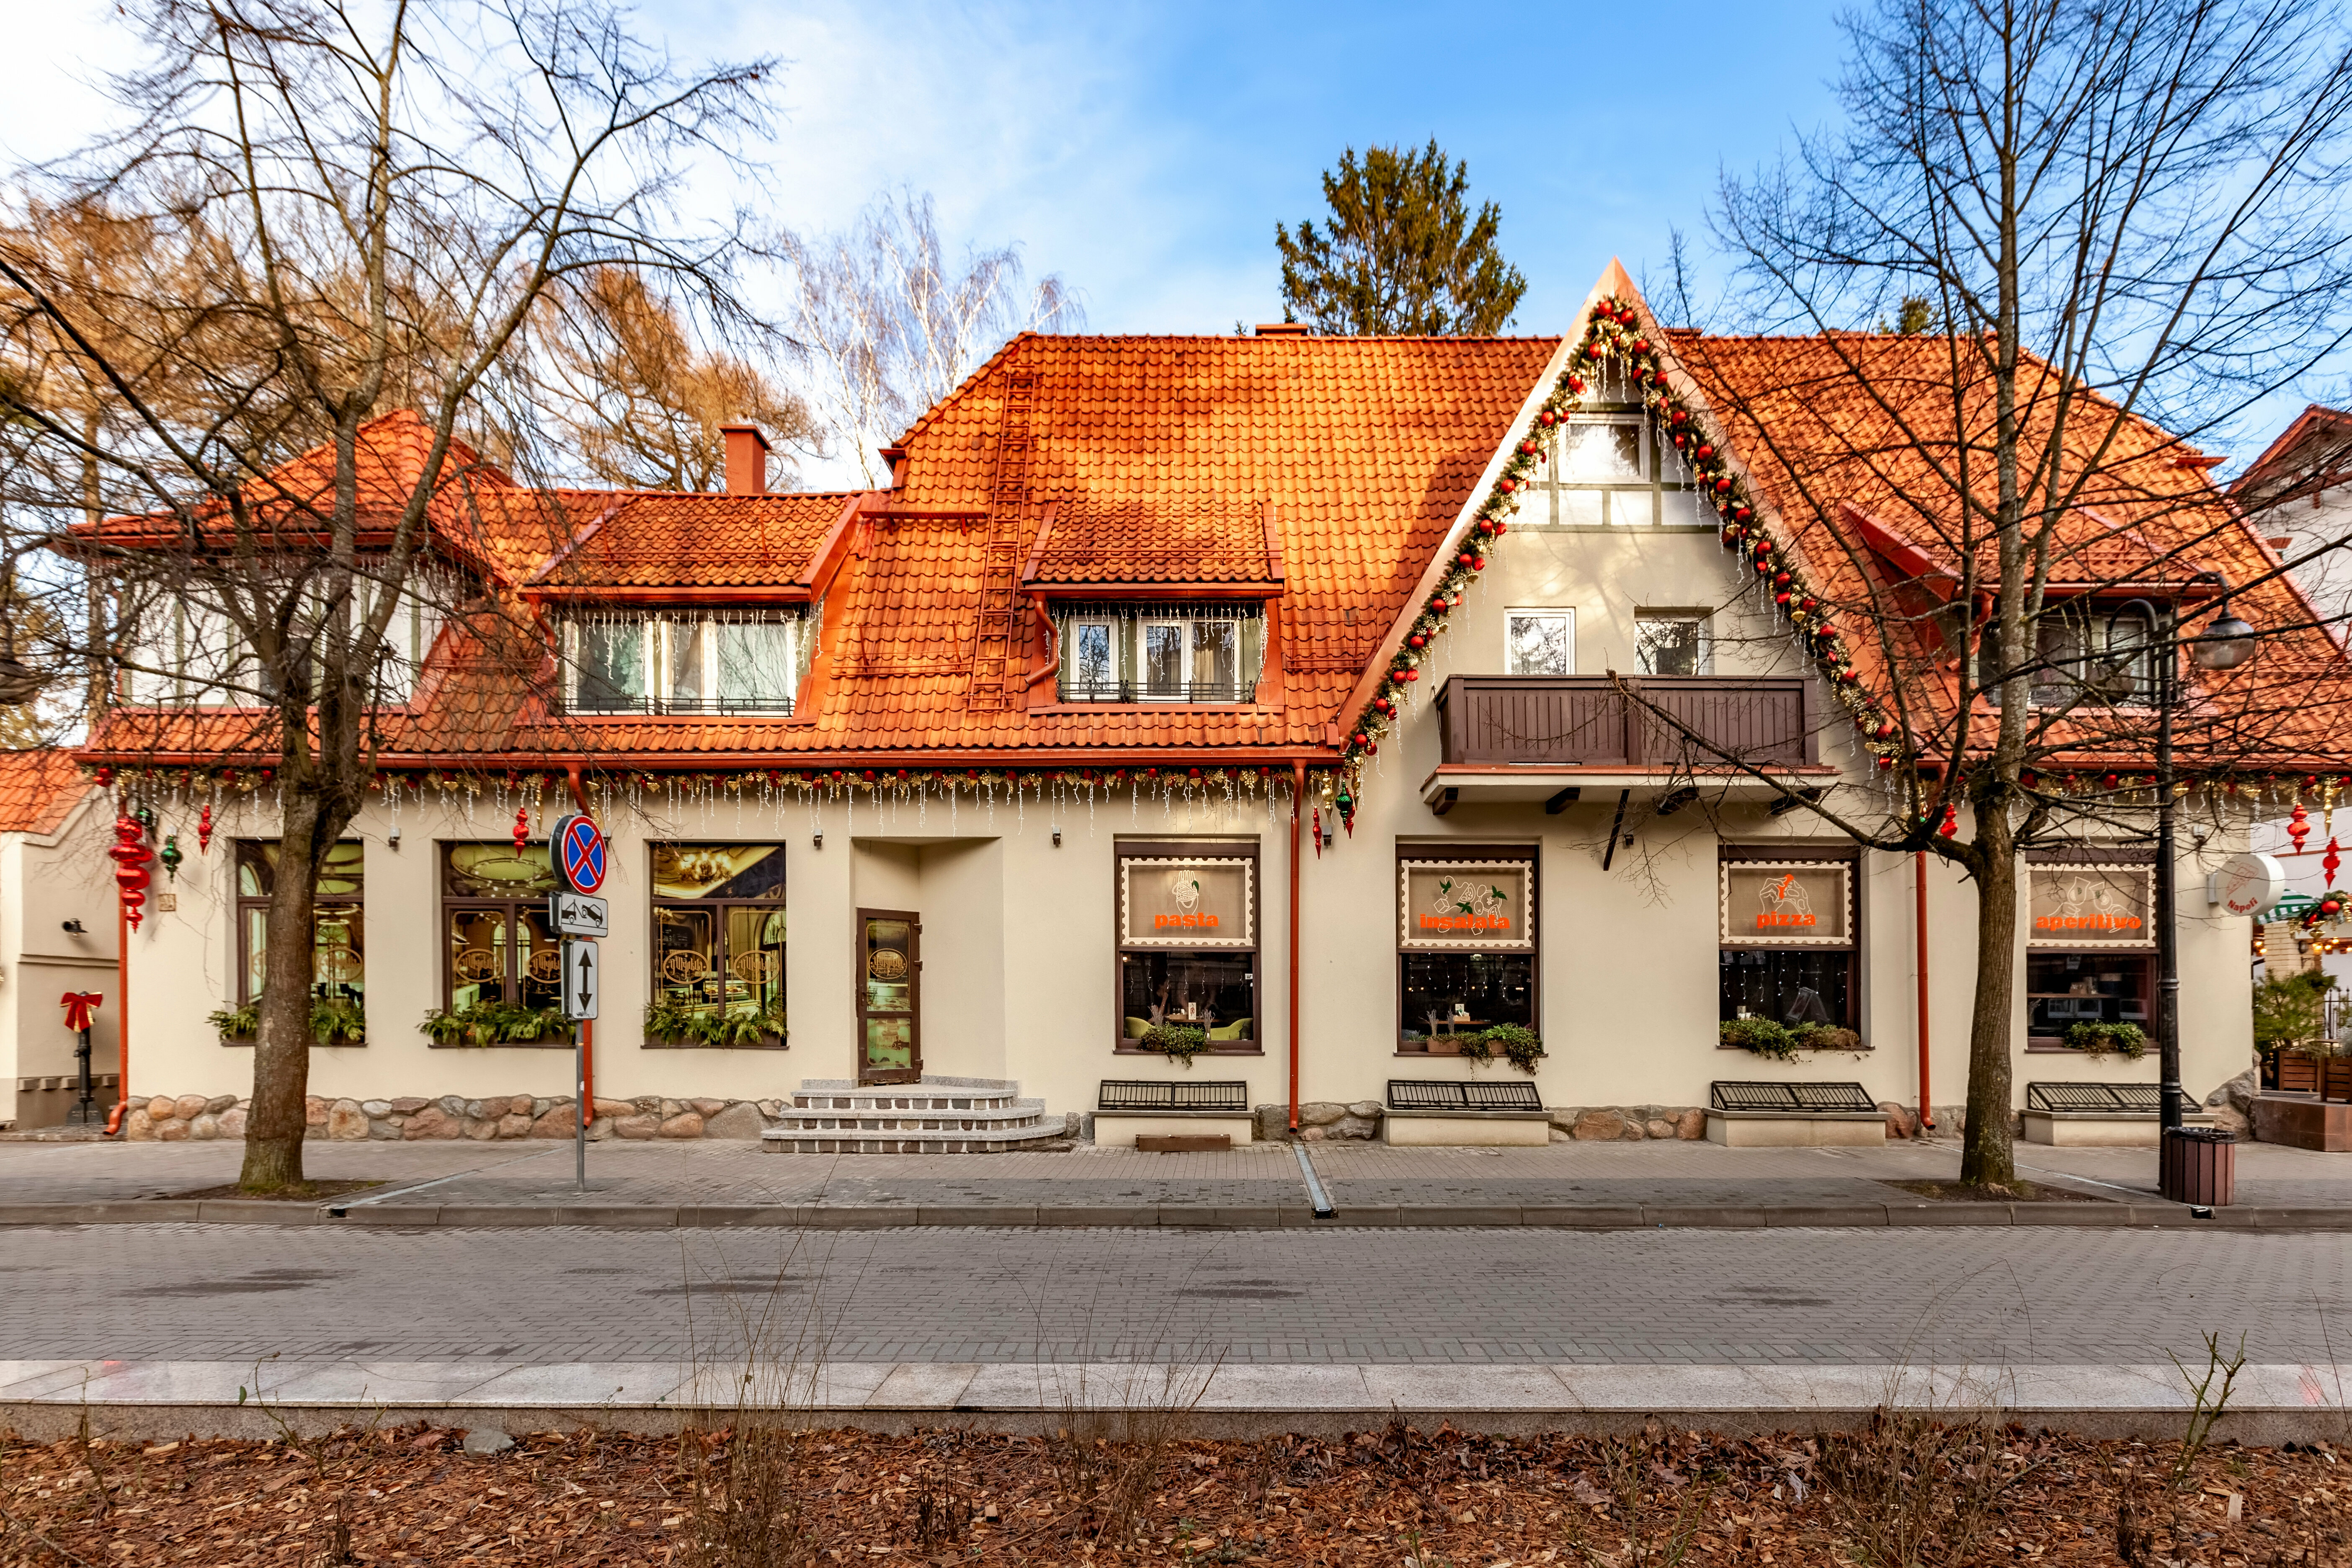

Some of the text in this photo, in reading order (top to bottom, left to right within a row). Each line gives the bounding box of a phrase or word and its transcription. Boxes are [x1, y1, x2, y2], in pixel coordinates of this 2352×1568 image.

[2227, 897, 2259, 913] Napoli
[1155, 912, 1219, 929] pasta
[1420, 913, 1510, 929] insalata
[1757, 911, 1816, 929] pizza
[2036, 914, 2142, 931] aperitivo
